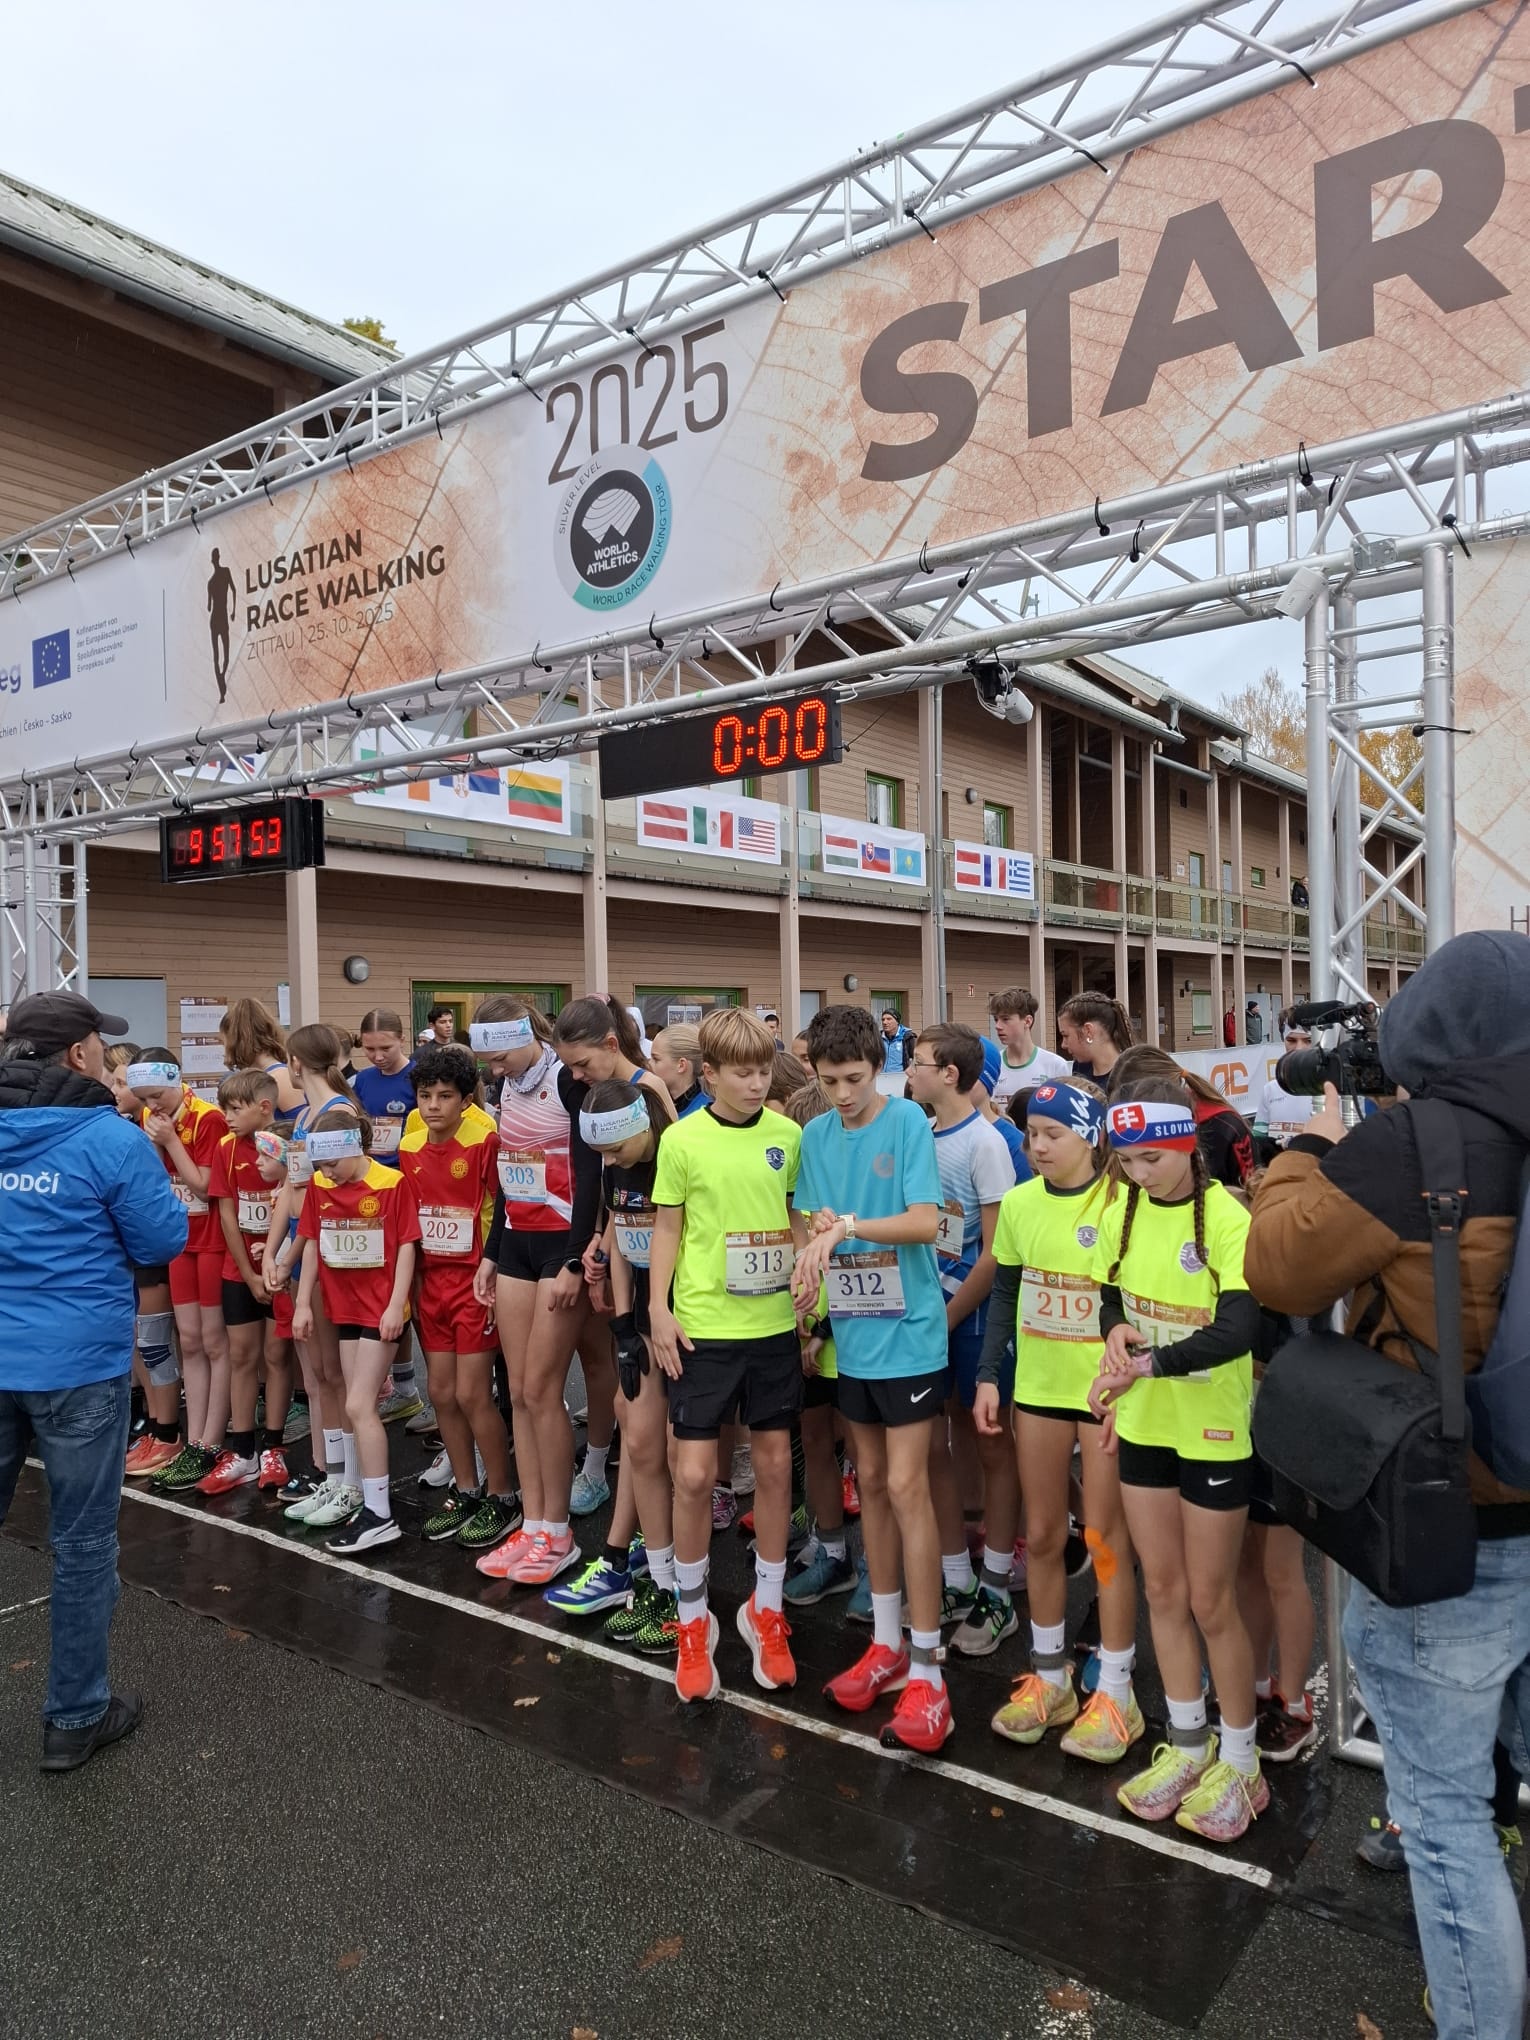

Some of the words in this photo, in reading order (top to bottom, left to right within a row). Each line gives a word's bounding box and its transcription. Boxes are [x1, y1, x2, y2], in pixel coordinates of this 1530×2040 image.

[860, 85, 1530, 482] STAR
[546, 319, 728, 485] 2025
[559, 494, 577, 534] SILVER
[575, 461, 602, 491] LEVEL
[655, 482, 667, 514] TOUR
[594, 541, 630, 560] WORLD
[646, 519, 667, 572] WALKING
[246, 528, 363, 594] LUSATIAN
[247, 587, 309, 632] RACE
[317, 545, 446, 610] WALKING
[624, 572, 648, 597] RACE
[593, 592, 624, 606] WORLD
[86, 628, 122, 647] Europäischen
[122, 621, 139, 634] Union
[108, 616, 118, 627] von
[247, 631, 295, 660] ZITTAU
[308, 622, 329, 643] 25.
[333, 615, 352, 637] 10.
[356, 601, 394, 630] 2025
[23, 717, 44, 732] Česko
[51, 710, 72, 725] Sasko
[713, 699, 826, 775] 0:00
[0, 1171, 60, 1194] ODČÍ
[505, 1166, 535, 1185] 303
[426, 1220, 459, 1240] 202
[334, 1234, 368, 1252] 103
[744, 1249, 783, 1274] 313
[838, 1272, 885, 1297] 312
[1036, 1291, 1093, 1322] 219
